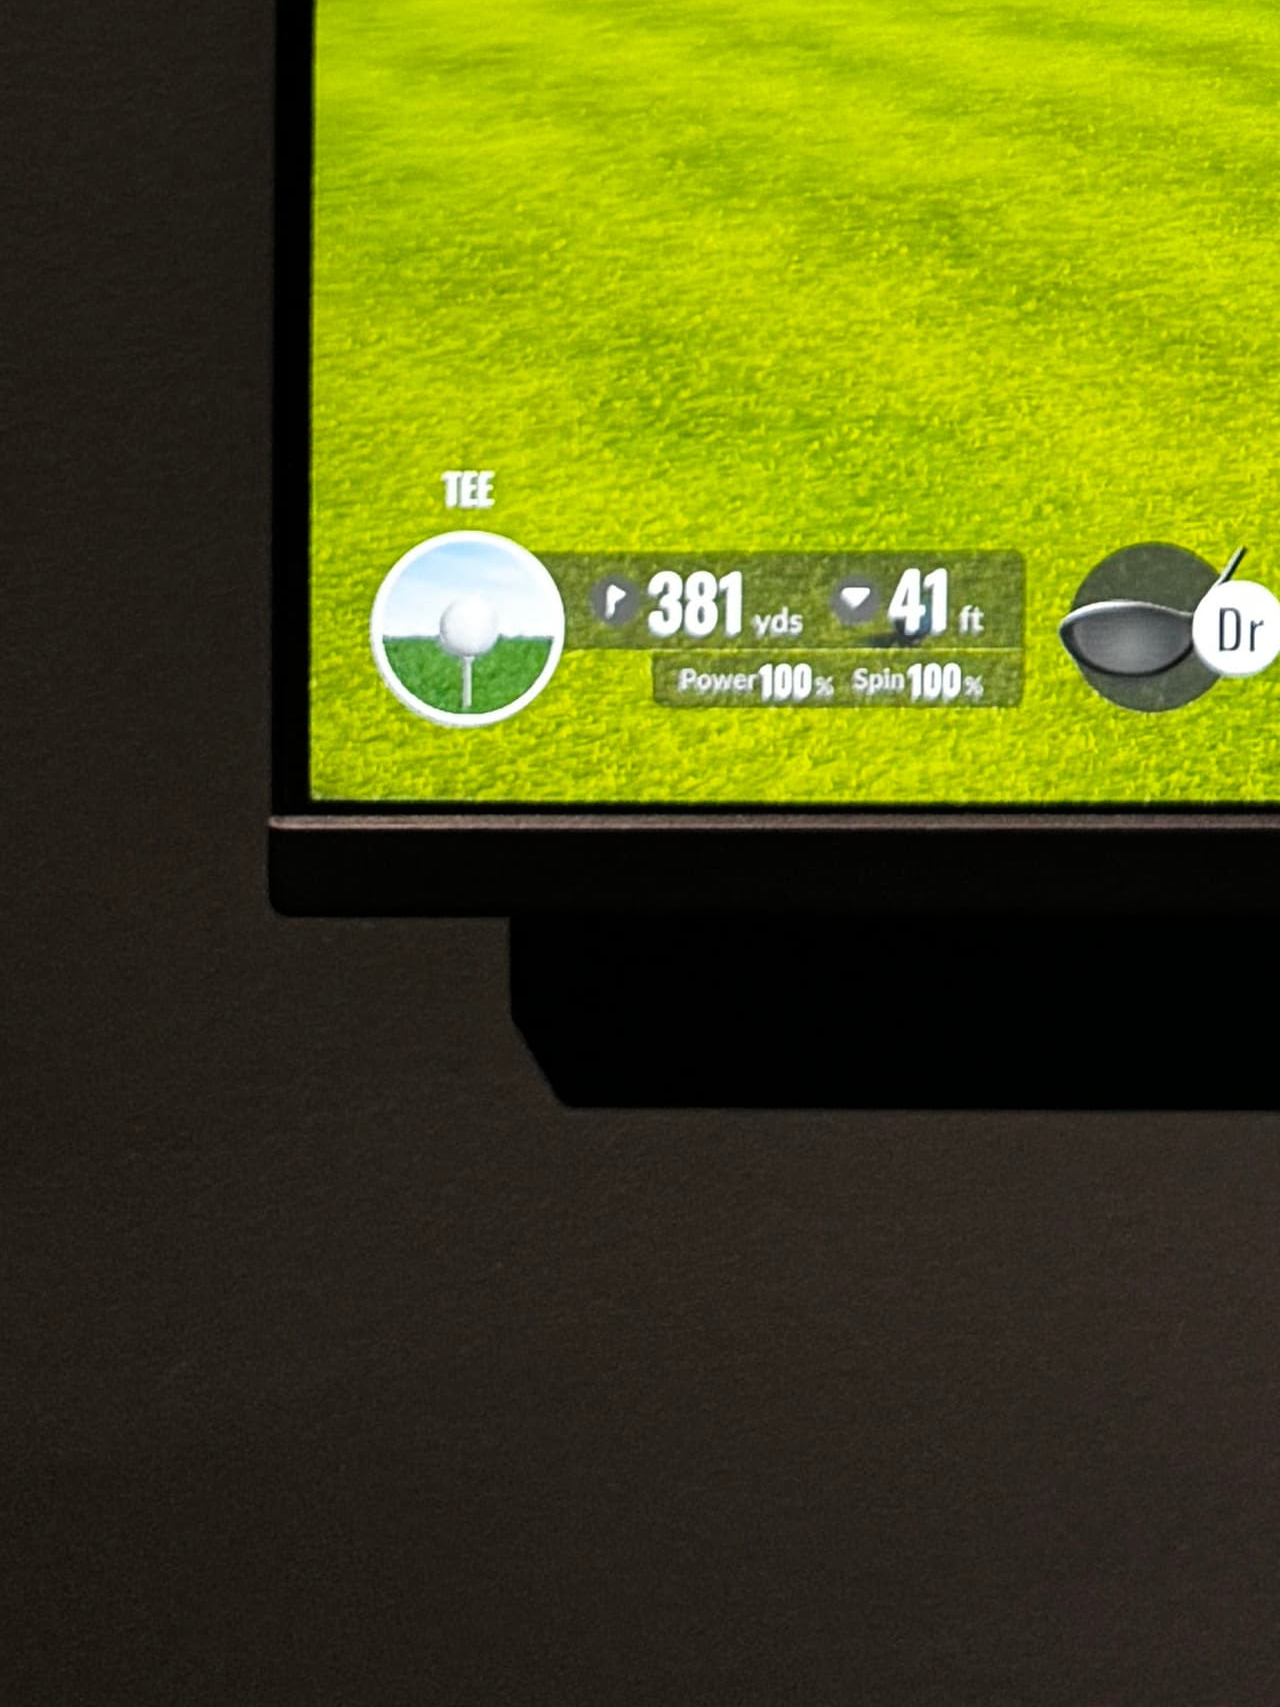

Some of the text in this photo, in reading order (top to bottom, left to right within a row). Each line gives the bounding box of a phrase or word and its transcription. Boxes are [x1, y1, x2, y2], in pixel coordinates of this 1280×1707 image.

[440, 470, 496, 510] TEE
[648, 570, 804, 637] 381 yds
[888, 567, 985, 636] 41 ft
[1218, 597, 1266, 655] Dr
